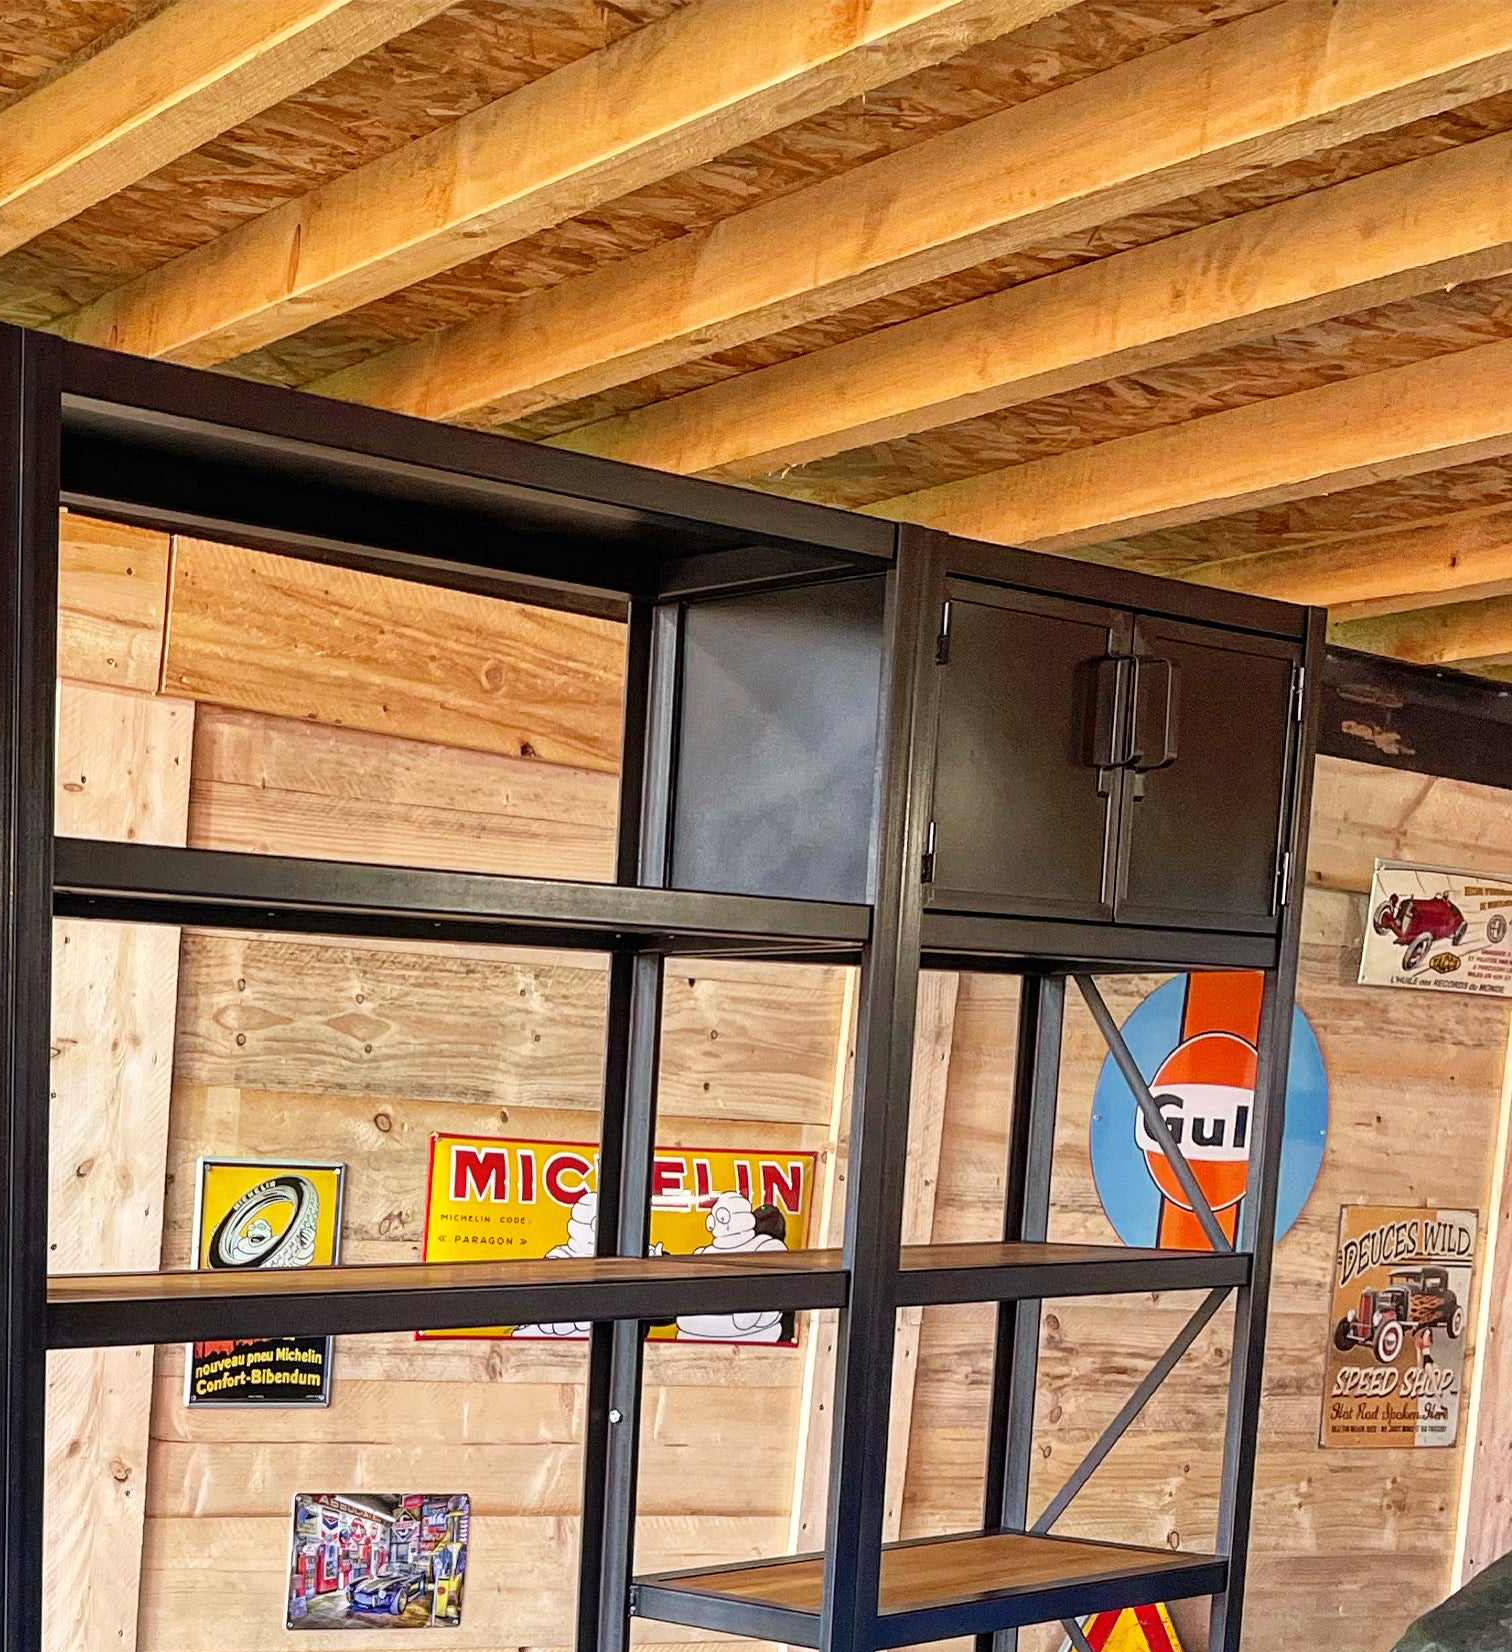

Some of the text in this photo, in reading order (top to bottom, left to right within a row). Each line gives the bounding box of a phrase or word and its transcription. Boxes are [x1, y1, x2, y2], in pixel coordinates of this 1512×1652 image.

[1144, 1093, 1250, 1149] Gul
[450, 1145, 804, 1215] MICELIN
[440, 1214, 491, 1223] MICHELIN
[454, 1235, 513, 1246] PARAGON
[1340, 1220, 1471, 1287] DEUCES WILD
[195, 1347, 322, 1379] nouveau pneu Michelin
[195, 1368, 321, 1396] Confort-Bibendum
[1331, 1366, 1455, 1398] SPEED SHOP
[1330, 1402, 1354, 1420] Hot
